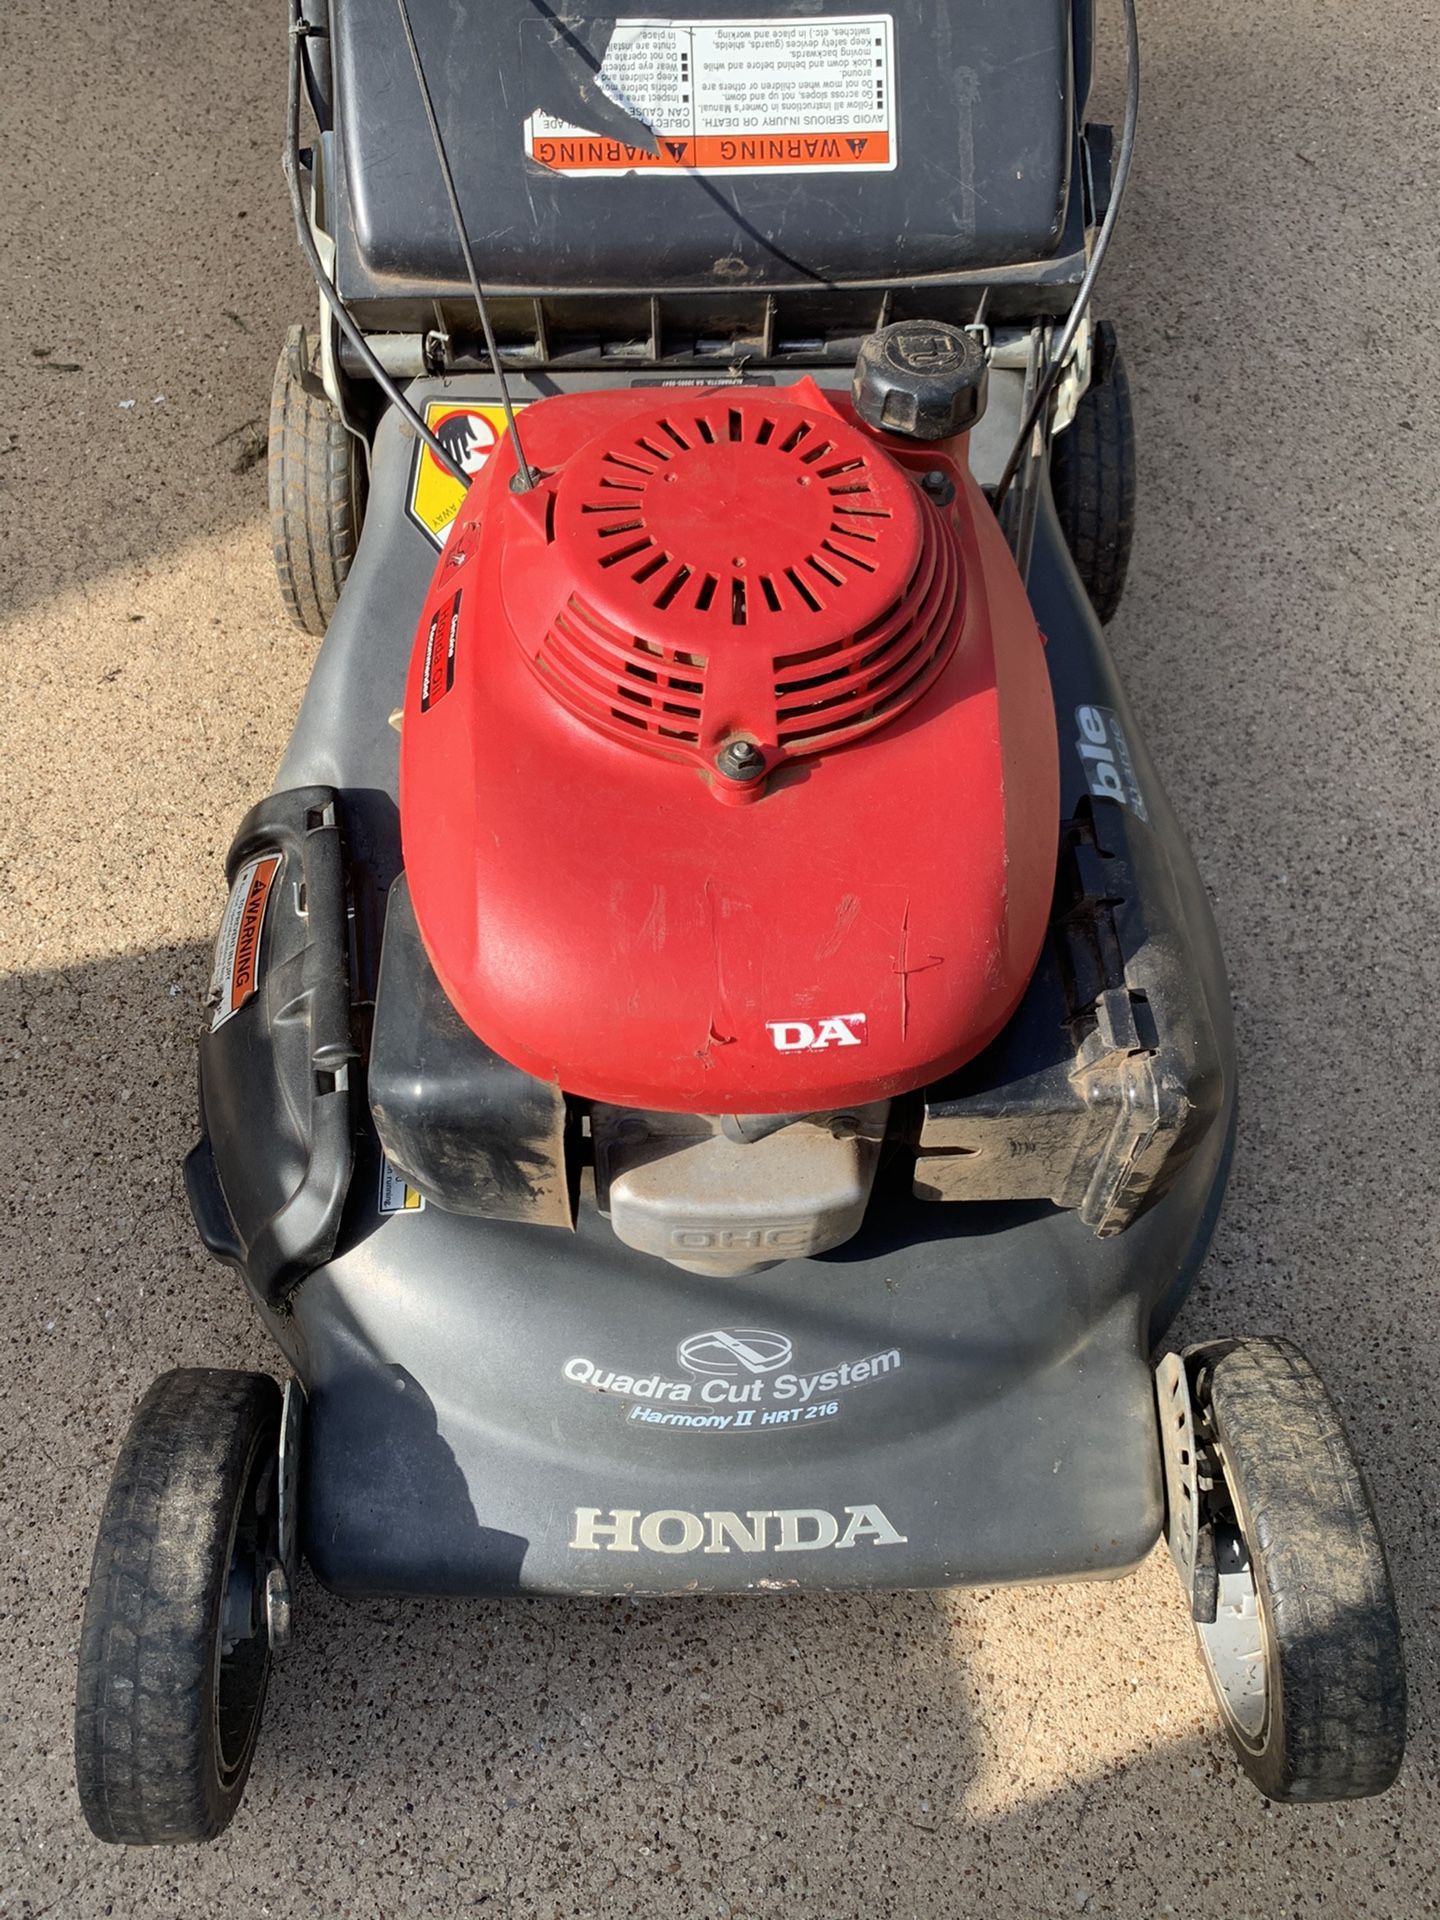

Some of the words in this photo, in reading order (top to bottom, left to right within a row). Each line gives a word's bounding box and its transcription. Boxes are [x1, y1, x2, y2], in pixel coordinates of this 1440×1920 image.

[640, 30, 665, 41] place.
[668, 32, 676, 41] in
[714, 30, 751, 40] working.
[754, 30, 770, 40] and
[772, 29, 796, 40] place
[798, 30, 806, 39] in
[809, 28, 829, 38] etc.)
[832, 28, 870, 38] switches,
[635, 42, 649, 50] are
[652, 42, 676, 51] chute
[712, 40, 746, 50] shields,
[748, 39, 784, 50] (guards,
[786, 40, 819, 50] devices
[822, 38, 847, 48] safety
[850, 36, 872, 48] Keep
[614, 51, 647, 62] operate
[650, 52, 663, 62] not
[666, 52, 677, 61] Do
[790, 50, 838, 59] backwards.
[840, 47, 871, 58] moving
[638, 61, 653, 70] eye
[656, 62, 678, 71] Wear
[703, 62, 725, 72] while
[728, 62, 744, 72] and
[746, 62, 774, 71] before
[777, 60, 806, 70] behind
[808, 60, 824, 70] and
[827, 60, 850, 68] down
[852, 59, 872, 68] Look
[601, 74, 616, 82] and
[620, 74, 654, 82] children
[656, 72, 678, 82] Keep
[840, 69, 872, 80] around.
[620, 84, 648, 93] before
[650, 83, 678, 93] debris
[702, 82, 716, 90] are
[718, 82, 746, 92] others
[749, 82, 758, 90] or
[760, 82, 796, 91] children
[798, 81, 820, 90] when
[822, 80, 843, 88] mow
[846, 80, 859, 89] not
[861, 80, 872, 89] Do
[626, 93, 645, 102] area
[648, 92, 679, 102] Inspect
[722, 92, 747, 101] down.
[750, 92, 766, 101] and
[768, 90, 780, 100] up
[782, 92, 796, 100] not
[798, 90, 828, 101] slopes,
[830, 90, 859, 98] across
[861, 90, 874, 99] Go
[698, 104, 732, 114] Manual.
[734, 103, 768, 112] Owner's
[770, 103, 779, 112] in
[782, 102, 831, 112] instructions
[834, 102, 844, 110] all
[846, 100, 874, 110] Follow
[630, 107, 664, 118] CAUSE
[668, 108, 690, 117] CAN
[702, 117, 739, 128] DEATH.
[743, 117, 759, 127] OR
[762, 116, 800, 126] INJURY
[803, 115, 850, 126] SERIOUS
[853, 114, 884, 124] AVOID
[720, 139, 840, 160] WARNING
[432, 504, 457, 528] AWAY
[434, 608, 448, 664] Honda
[448, 614, 458, 658] Genuine
[422, 622, 437, 700] Recommended
[432, 668, 443, 696] Oil
[230, 910, 242, 947] PREVENT
[236, 897, 262, 988] WARNING
[226, 949, 235, 981] INJURY
[670, 1229, 811, 1250] OHC
[564, 1358, 690, 1402] Quadra
[700, 1378, 764, 1403] Cut
[772, 1348, 902, 1402] System
[630, 1406, 734, 1429] Harmony
[732, 1409, 756, 1426] II
[761, 1408, 803, 1425] HRT
[804, 1401, 839, 1419] 216
[567, 1503, 909, 1553] HONDA
